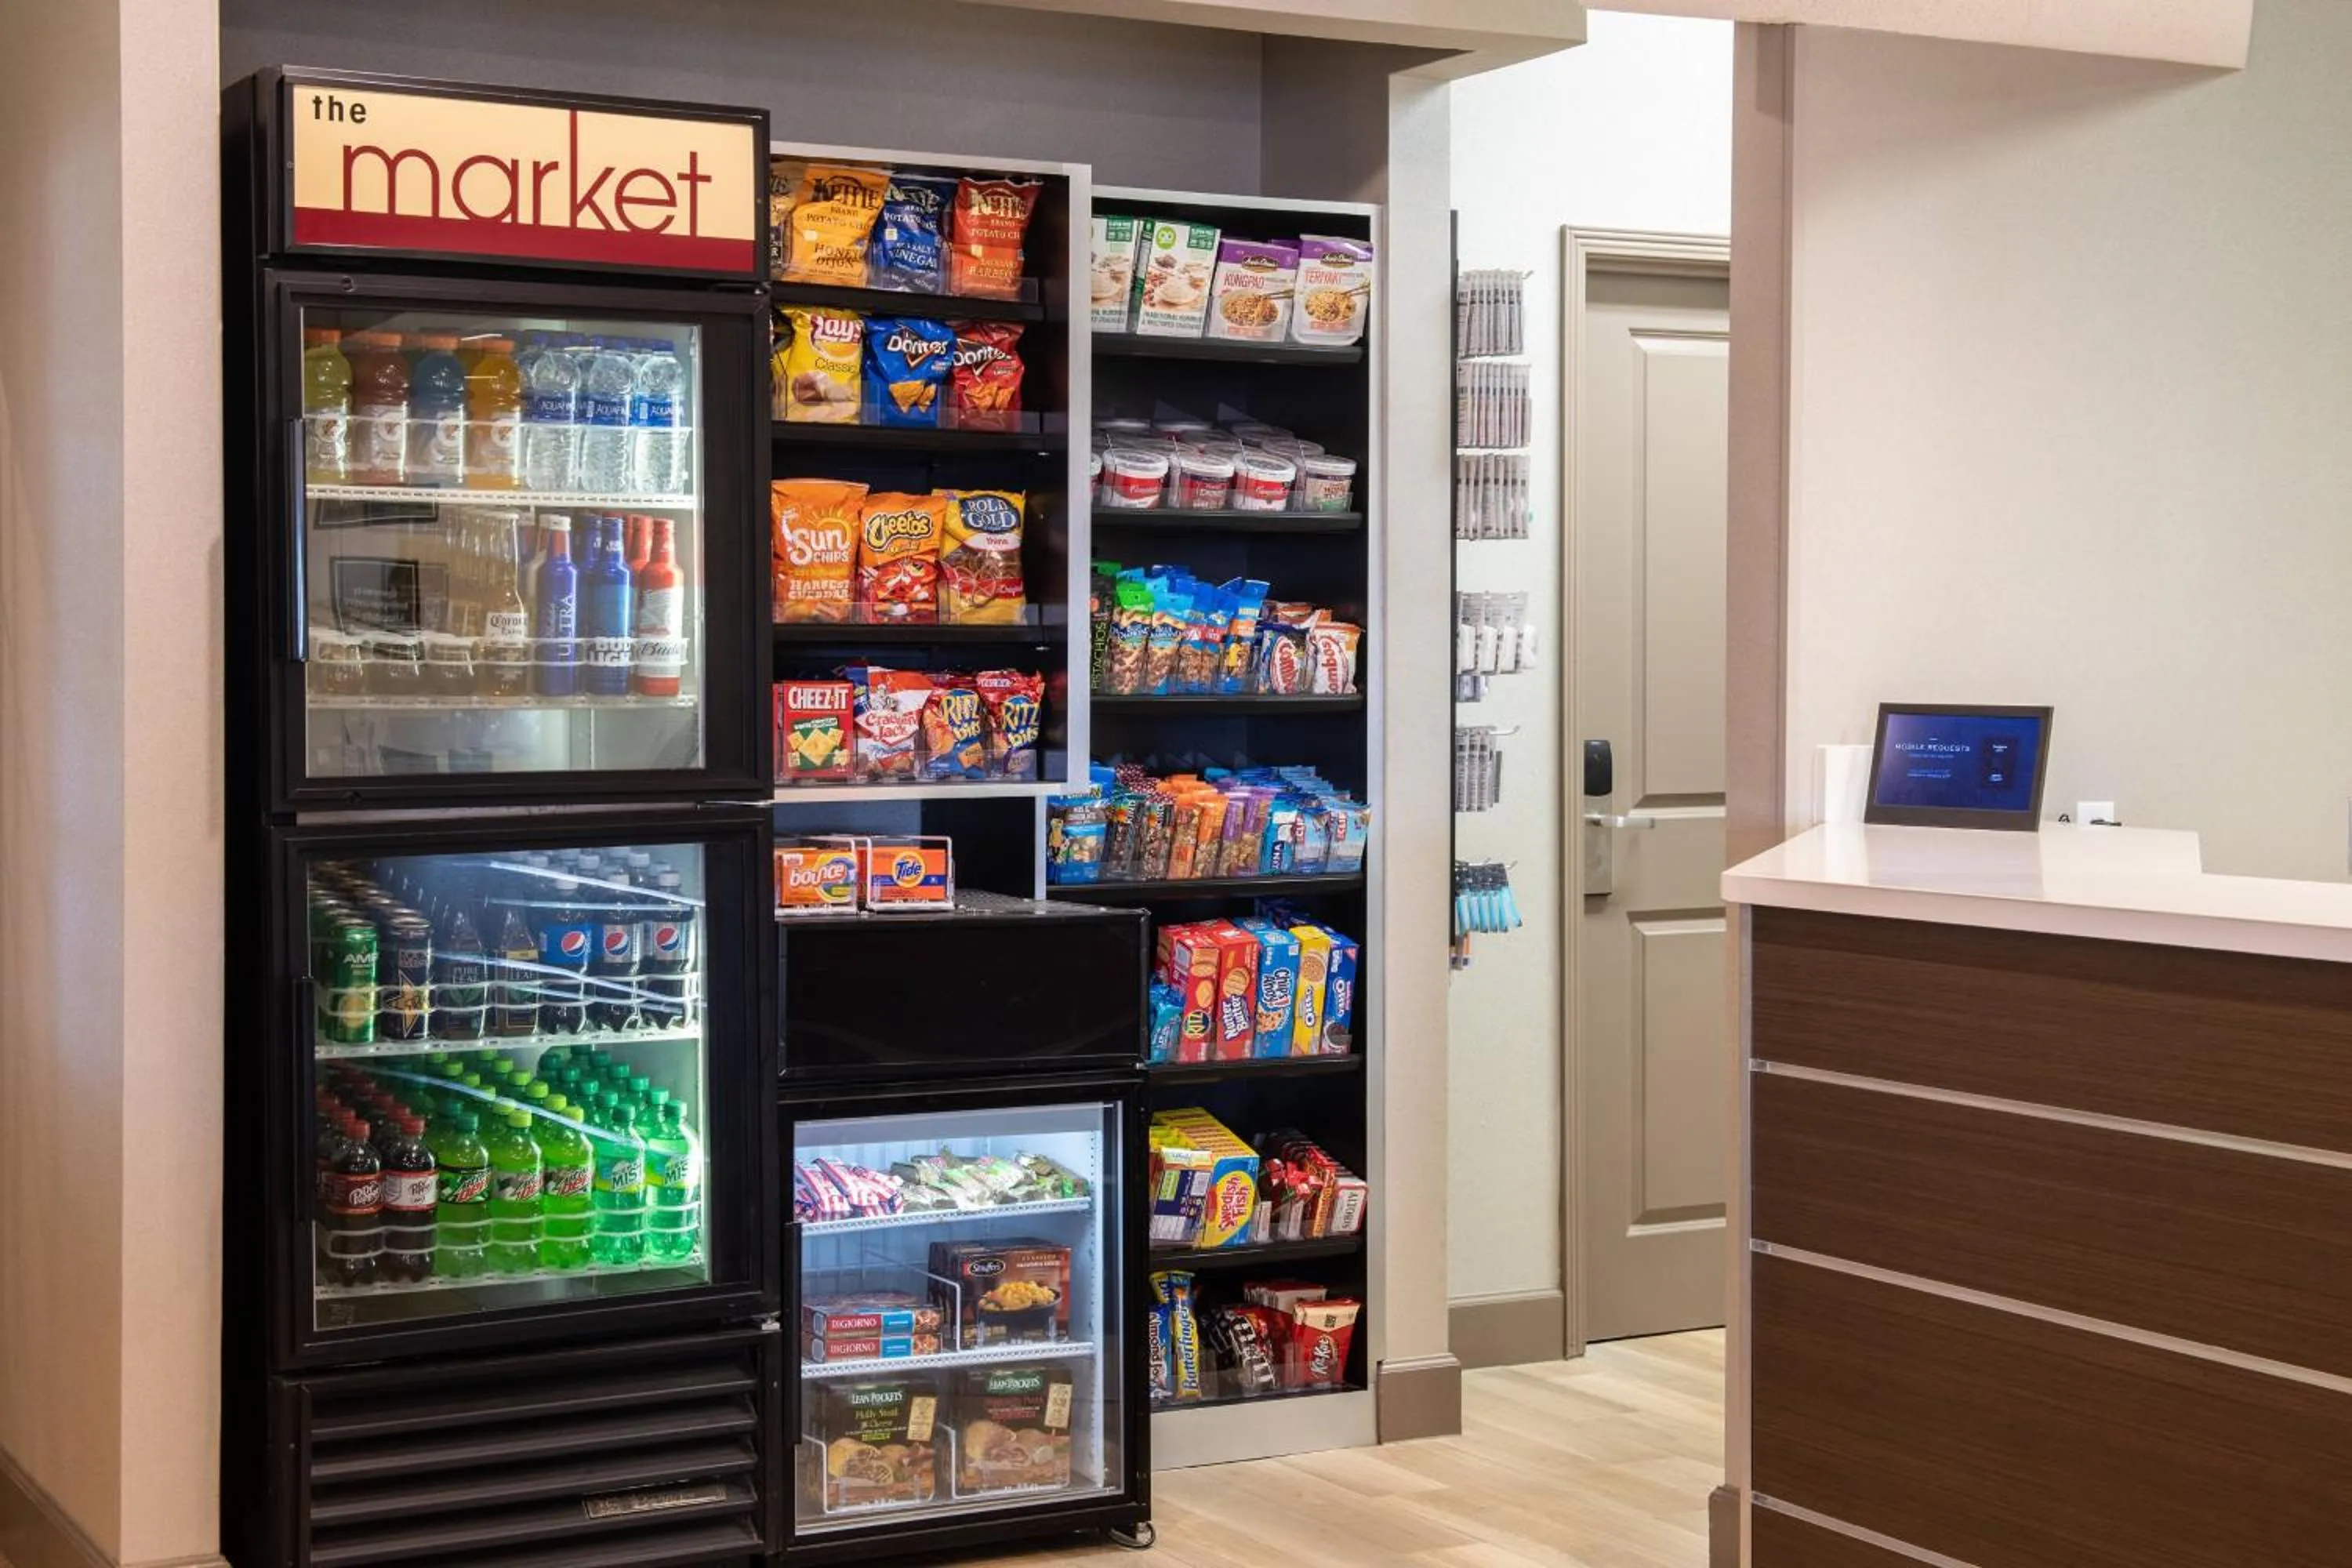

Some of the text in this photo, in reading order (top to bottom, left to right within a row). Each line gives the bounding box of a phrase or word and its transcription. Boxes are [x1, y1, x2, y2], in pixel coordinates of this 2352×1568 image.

[313, 95, 367, 124] the
[343, 110, 713, 236] market
[887, 335, 949, 354] Doritos
[815, 357, 857, 374] Classic
[967, 499, 1007, 512] ROLD
[867, 512, 931, 549] Cheetos
[967, 510, 1017, 528] GOLD
[789, 528, 851, 566] Sun
[812, 550, 849, 564] CHIPS
[1003, 702, 1040, 731] RITZ
[1007, 728, 1039, 748] bits
[1928, 744, 1971, 753] REQUESTS
[789, 863, 845, 887] bounce
[895, 861, 922, 878] Tide
[1188, 1012, 1204, 1034] RITZ
[1222, 1000, 1237, 1040] Nutter
[1232, 993, 1250, 1031] Butter
[1218, 1175, 1241, 1232] Swedish
[1232, 1185, 1249, 1218] Fish
[1179, 1306, 1196, 1390] Butterfinger
